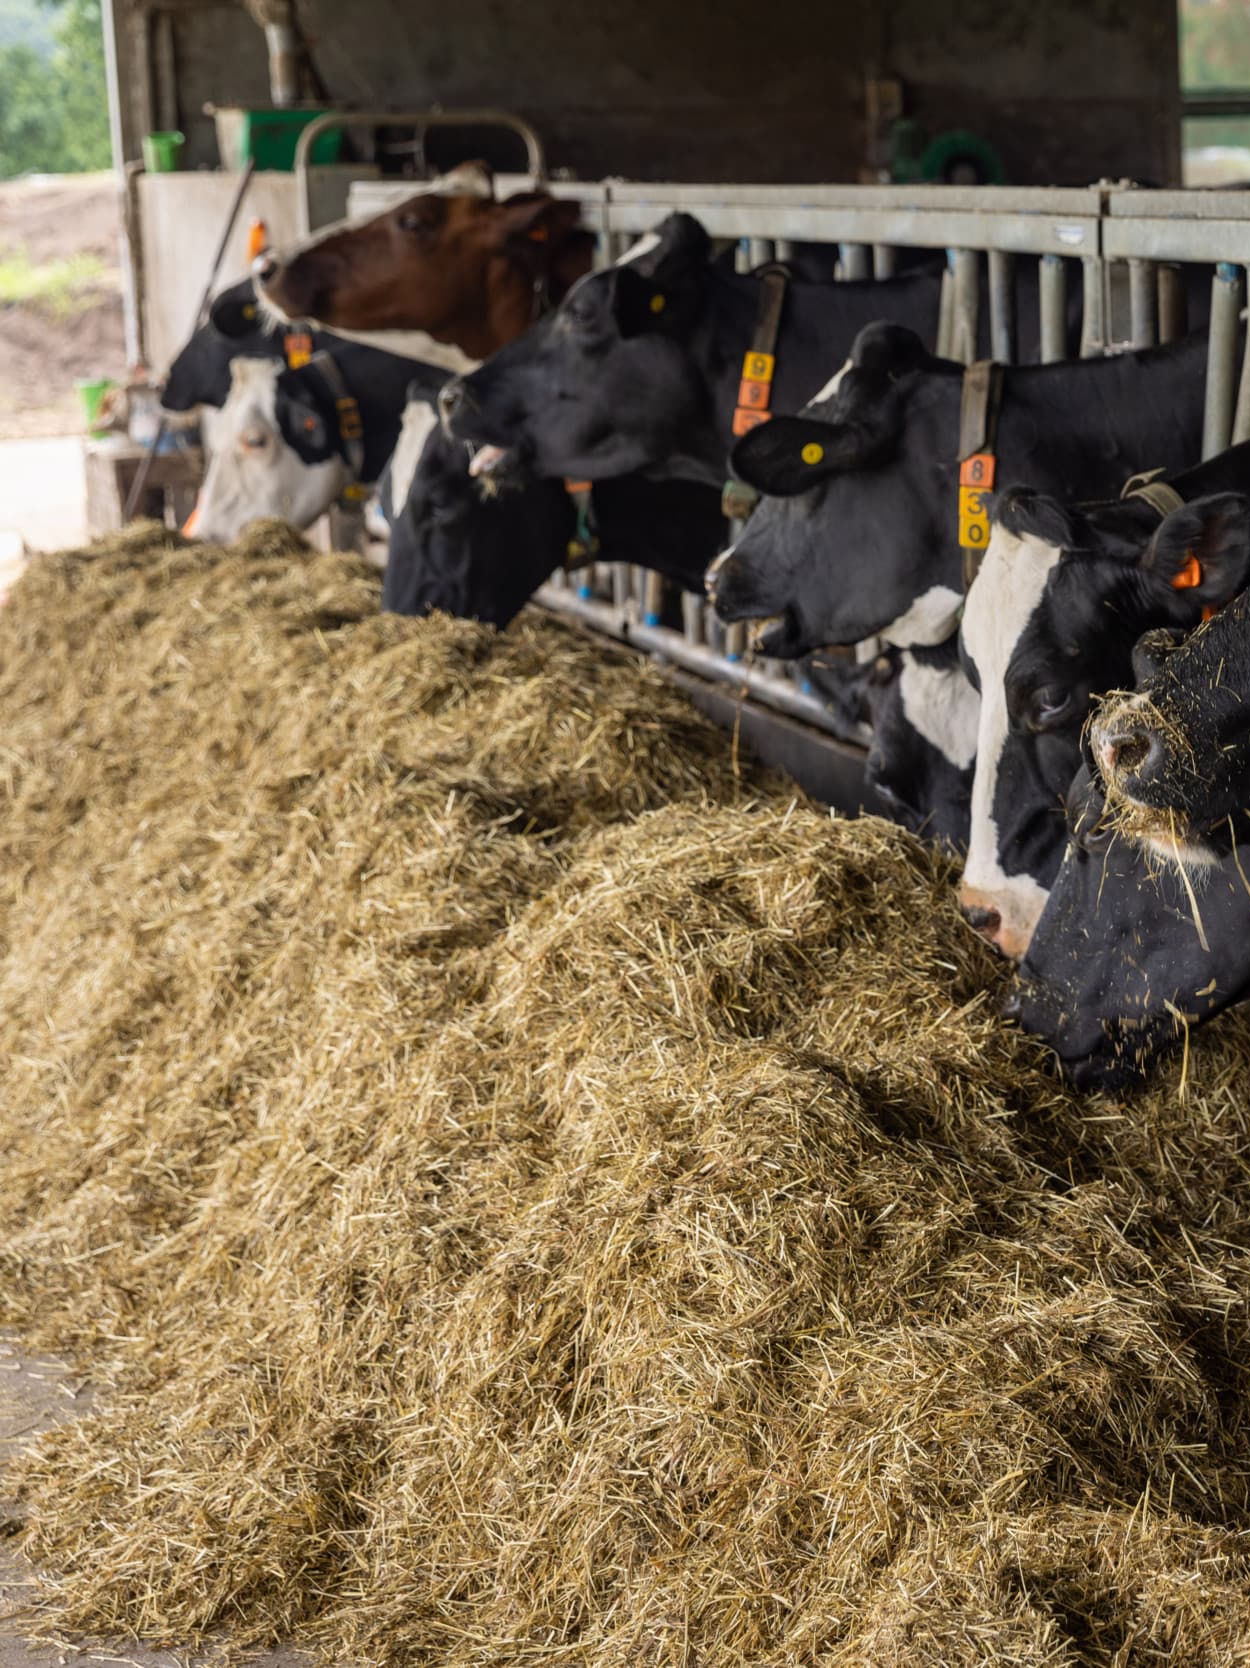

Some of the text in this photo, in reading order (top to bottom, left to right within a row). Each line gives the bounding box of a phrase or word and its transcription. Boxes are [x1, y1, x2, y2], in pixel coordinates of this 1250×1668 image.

[971, 459, 983, 481] 8
[967, 492, 983, 514] 3
[968, 524, 983, 543] 0
